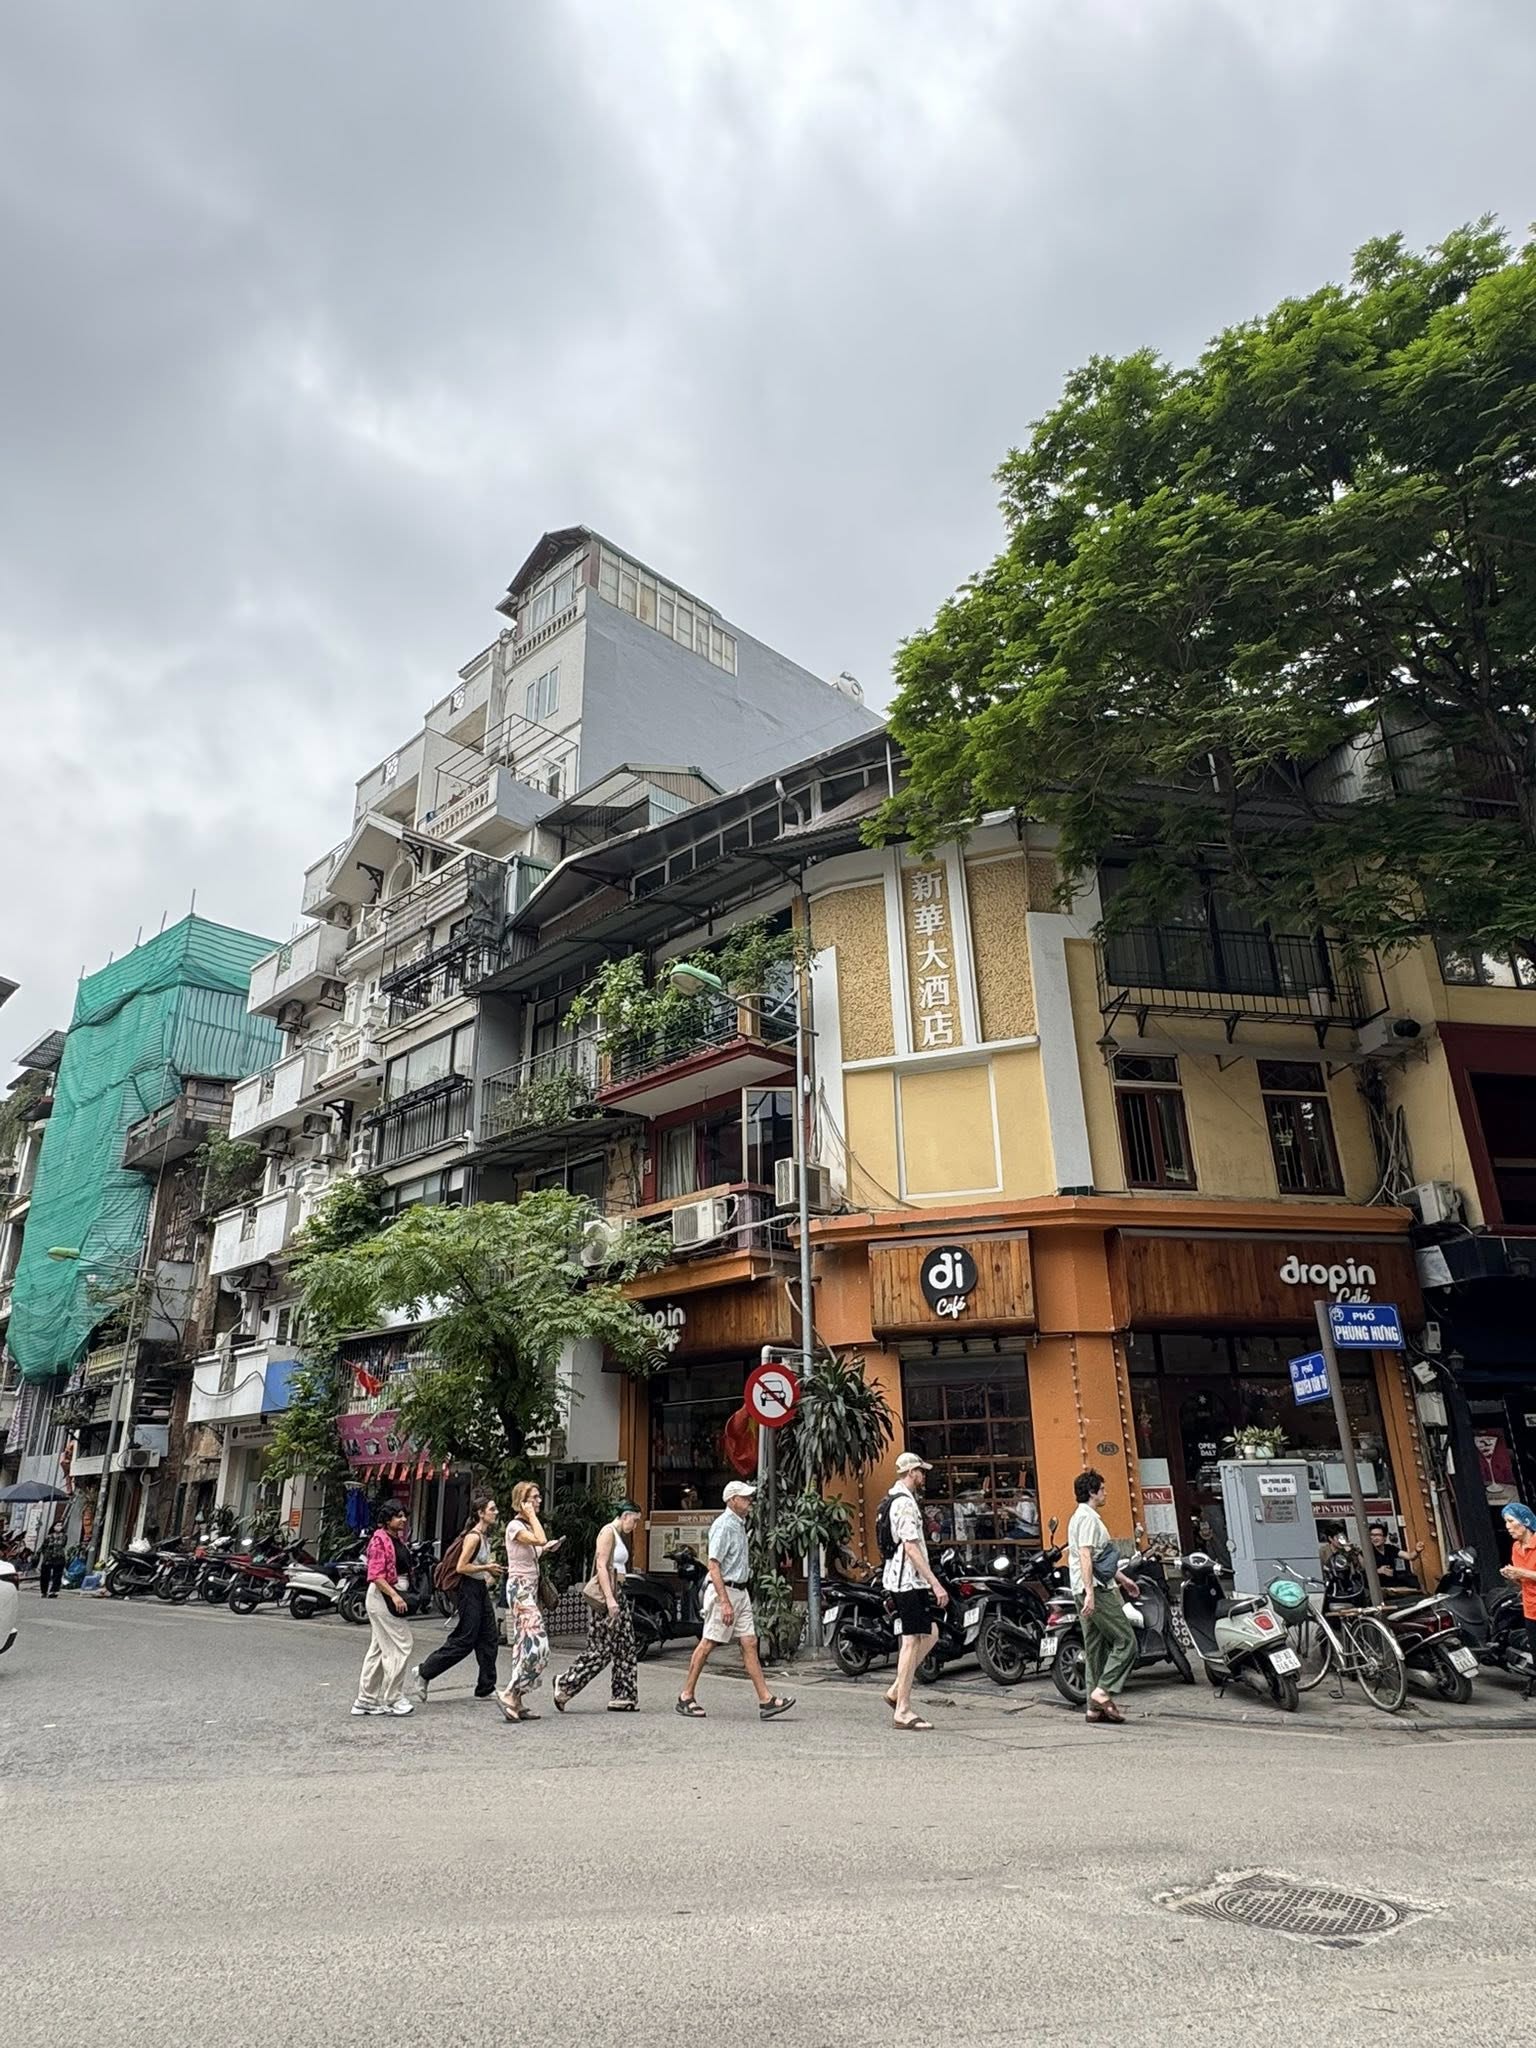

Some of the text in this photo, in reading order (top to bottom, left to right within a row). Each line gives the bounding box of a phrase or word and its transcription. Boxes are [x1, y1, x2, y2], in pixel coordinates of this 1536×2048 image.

[911, 869, 953, 1048] 新華大酒店
[928, 1252, 963, 1290] di
[1279, 1255, 1377, 1293] dropin
[936, 1295, 966, 1319] Café
[1352, 1308, 1376, 1322] PHỐ
[1334, 1321, 1400, 1342] PHÙNG HƯNG
[1198, 1442, 1217, 1450] OPEN
[1143, 1492, 1167, 1500] MENU
